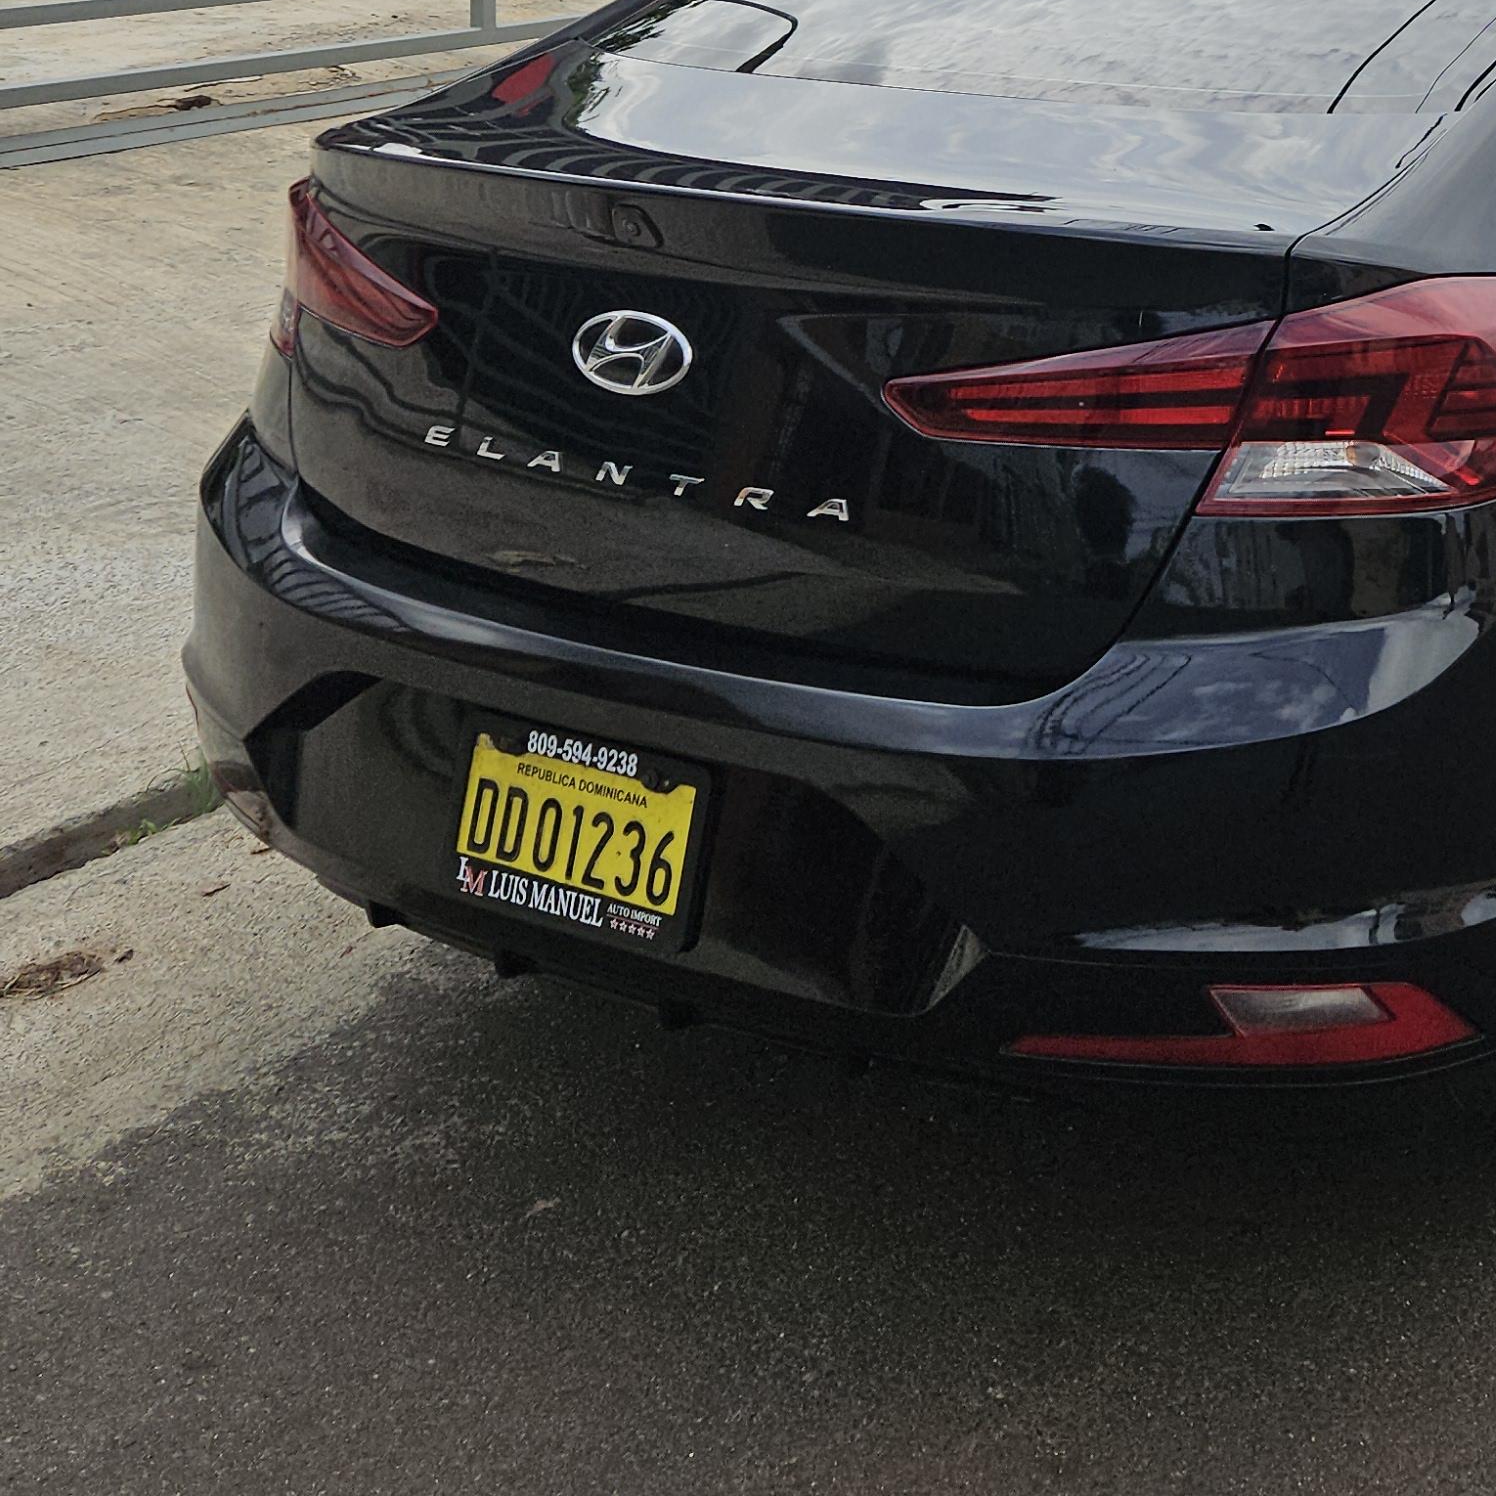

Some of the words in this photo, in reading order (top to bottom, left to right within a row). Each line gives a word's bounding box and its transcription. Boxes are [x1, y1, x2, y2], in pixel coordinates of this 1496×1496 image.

[424, 425, 849, 522] ELANTRA
[527, 730, 638, 777] 809-594-9238
[517, 762, 577, 789] REPUBLICA
[578, 778, 648, 808] DOMINICANA
[467, 777, 674, 906] DD01236
[487, 869, 528, 905] LUIS
[528, 878, 604, 927] MANUEL
[606, 902, 629, 919] AUTO
[631, 909, 663, 927] IMPORT
